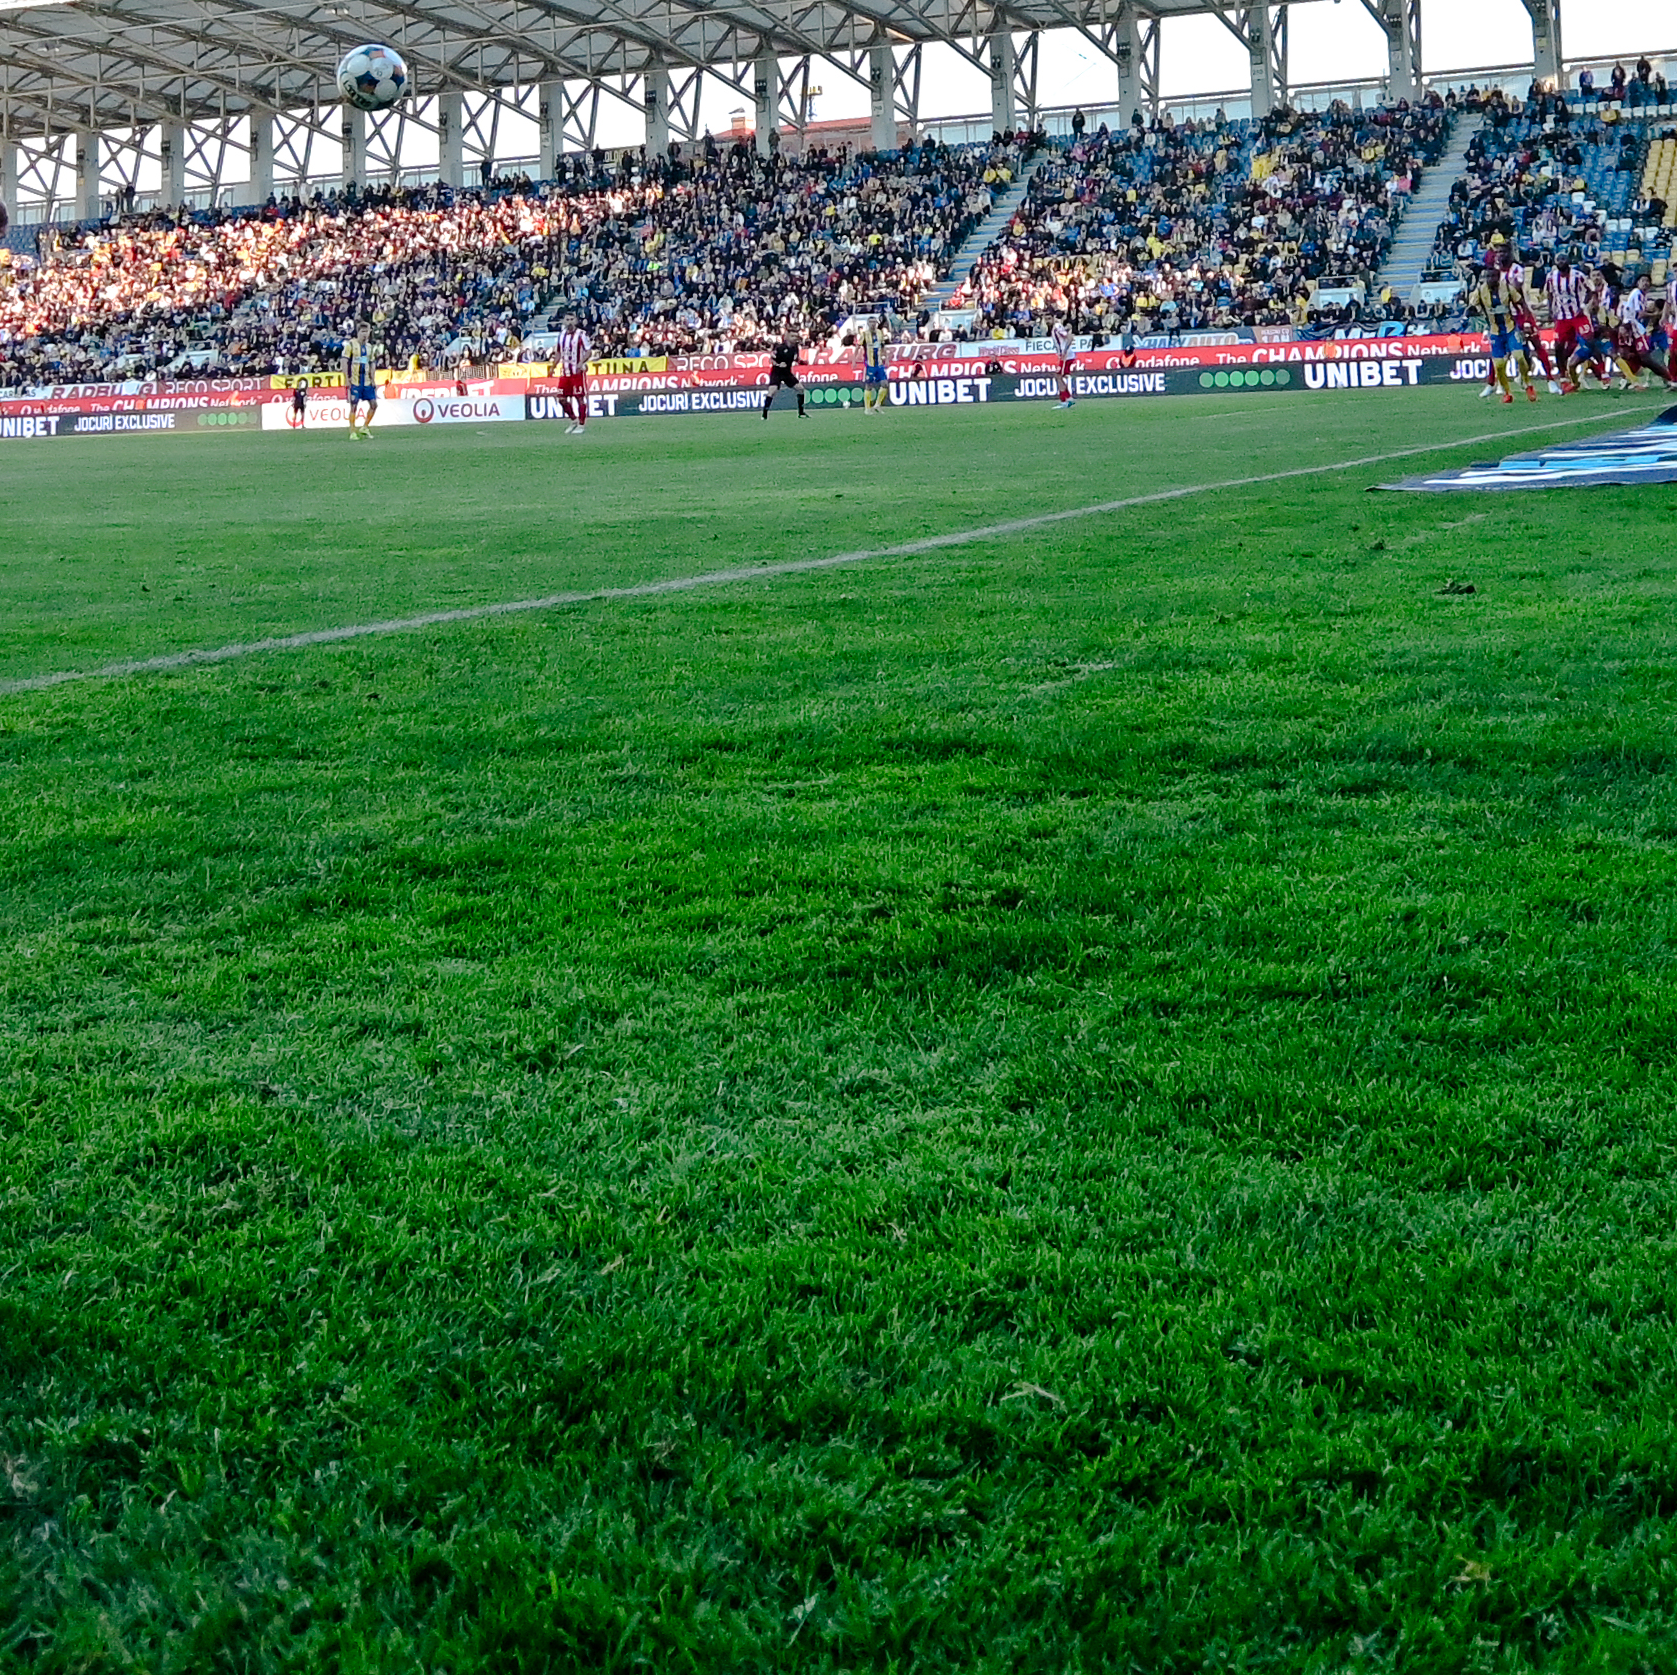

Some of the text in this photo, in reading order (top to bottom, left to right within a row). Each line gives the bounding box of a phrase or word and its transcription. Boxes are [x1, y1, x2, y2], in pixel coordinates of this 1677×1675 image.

[1135, 354, 1200, 368] odafone
[1304, 359, 1423, 389] UNIBET
[889, 377, 992, 406] UNIBET
[1076, 372, 1166, 395] EXCLUSIVE
[437, 403, 501, 419] VEOLIA
[639, 391, 689, 412] JOCURI
[74, 415, 112, 432] JOCURI
[115, 413, 176, 431] EXCLUSIVE
